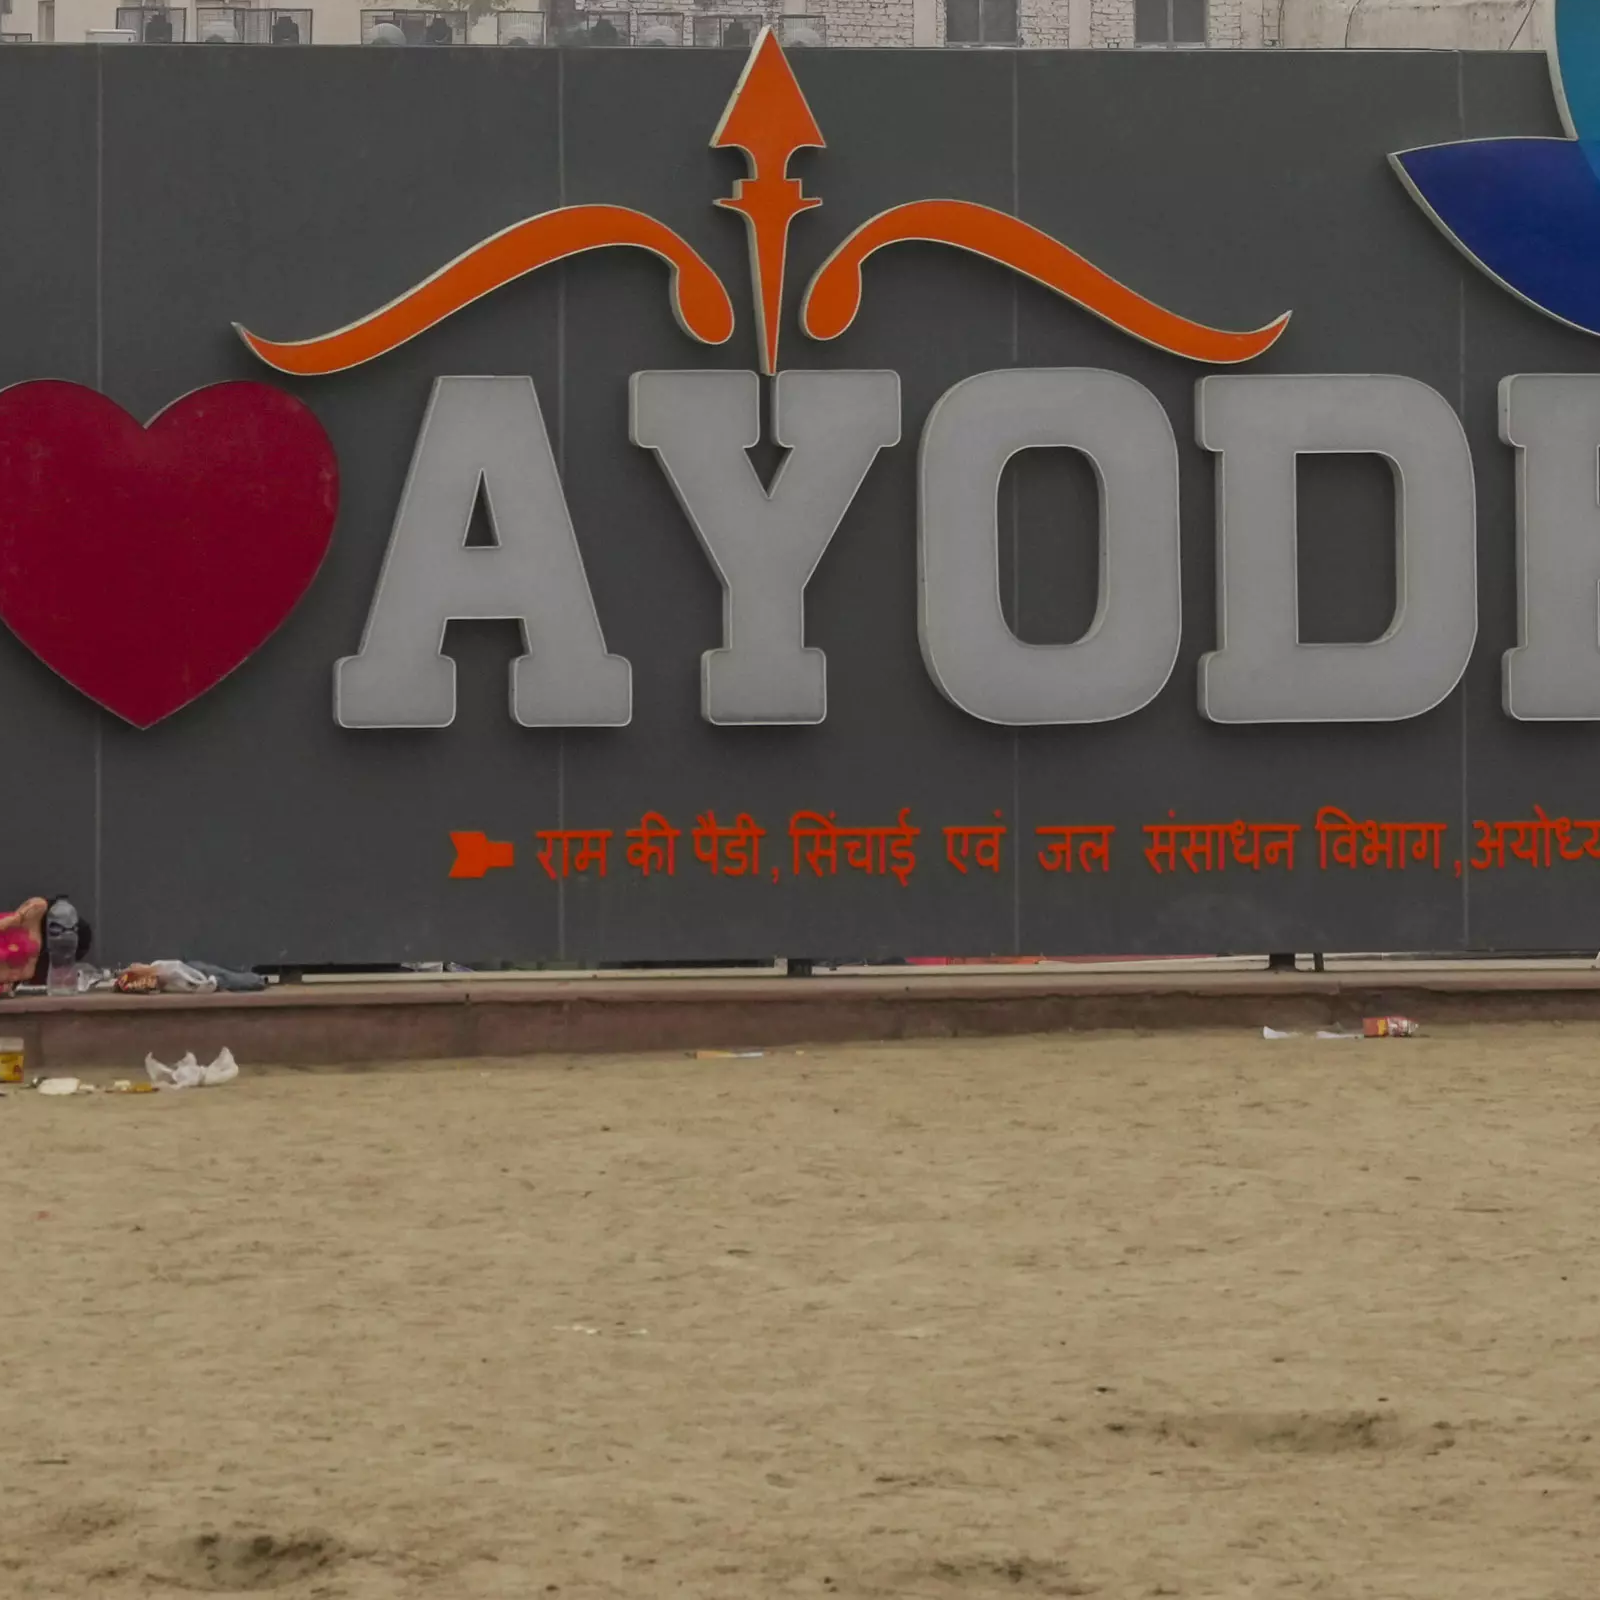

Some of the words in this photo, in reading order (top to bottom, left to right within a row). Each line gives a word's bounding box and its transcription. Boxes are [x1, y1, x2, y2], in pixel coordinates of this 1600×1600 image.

[536, 830, 613, 879] राम
[626, 811, 681, 876] की
[788, 808, 920, 886] सिंचाई
[943, 809, 1006, 873] एवं
[1036, 825, 1115, 872] जल
[1143, 810, 1301, 873] संसाधन
